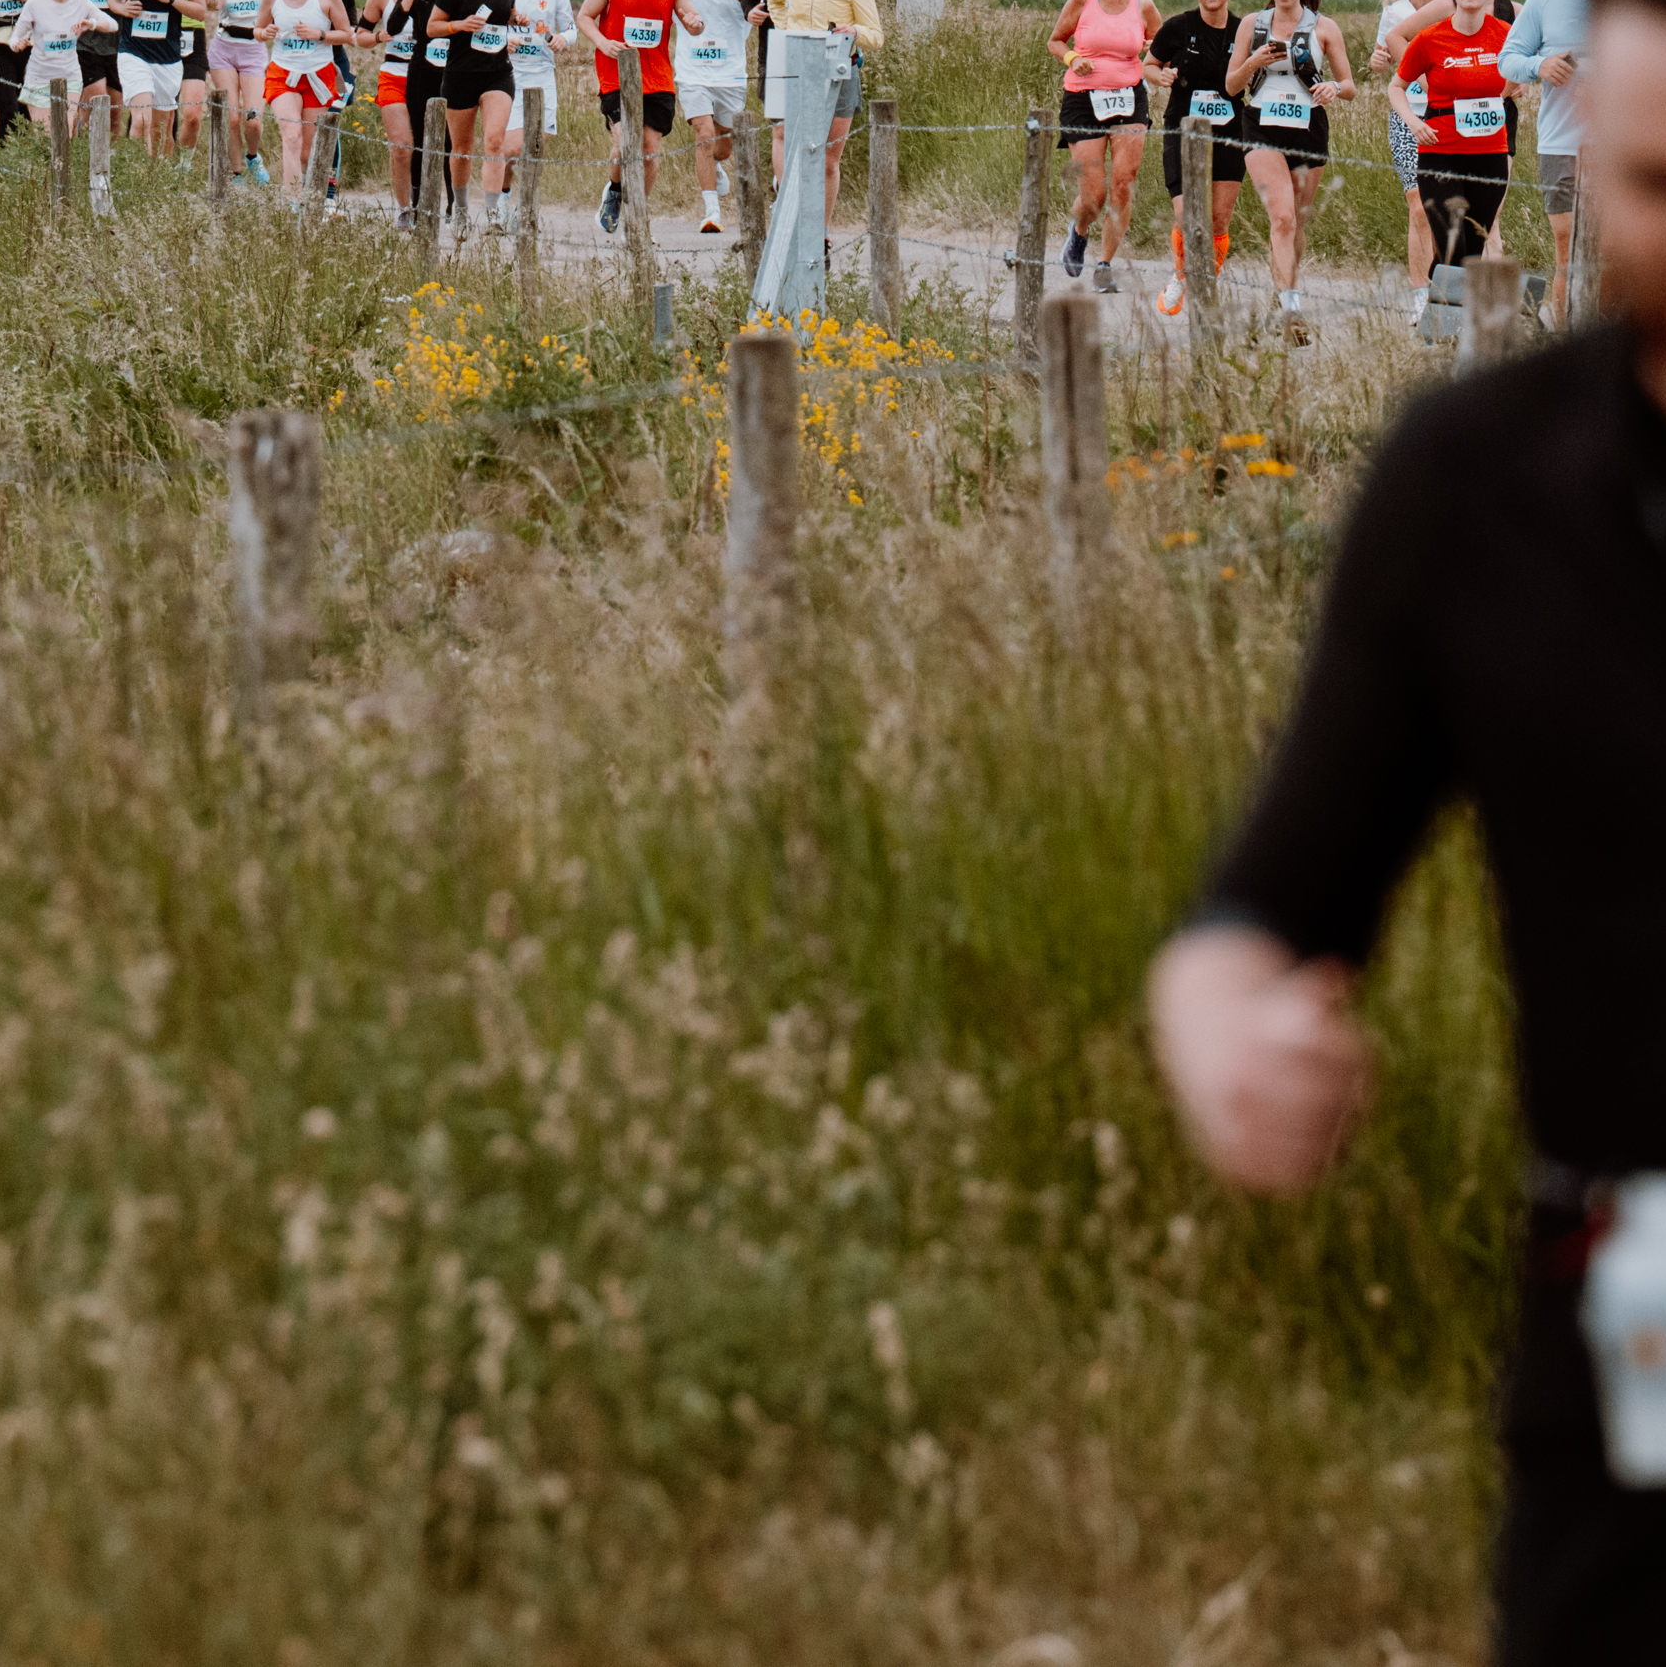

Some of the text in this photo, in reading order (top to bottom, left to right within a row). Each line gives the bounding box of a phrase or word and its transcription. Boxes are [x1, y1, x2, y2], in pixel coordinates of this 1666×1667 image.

[233, 1, 255, 11] 4220
[138, 20, 162, 31] 4617
[478, 32, 500, 45] 4538
[630, 28, 656, 41] 4338
[49, 39, 72, 50] 4467
[287, 39, 310, 49] 4171
[516, 44, 537, 55] 352
[433, 48, 448, 59] 45
[696, 48, 721, 58] 4431
[1103, 96, 1125, 109] 173
[1198, 102, 1228, 116] 4665
[1269, 103, 1302, 118] 4636
[1464, 111, 1497, 127] 4308
